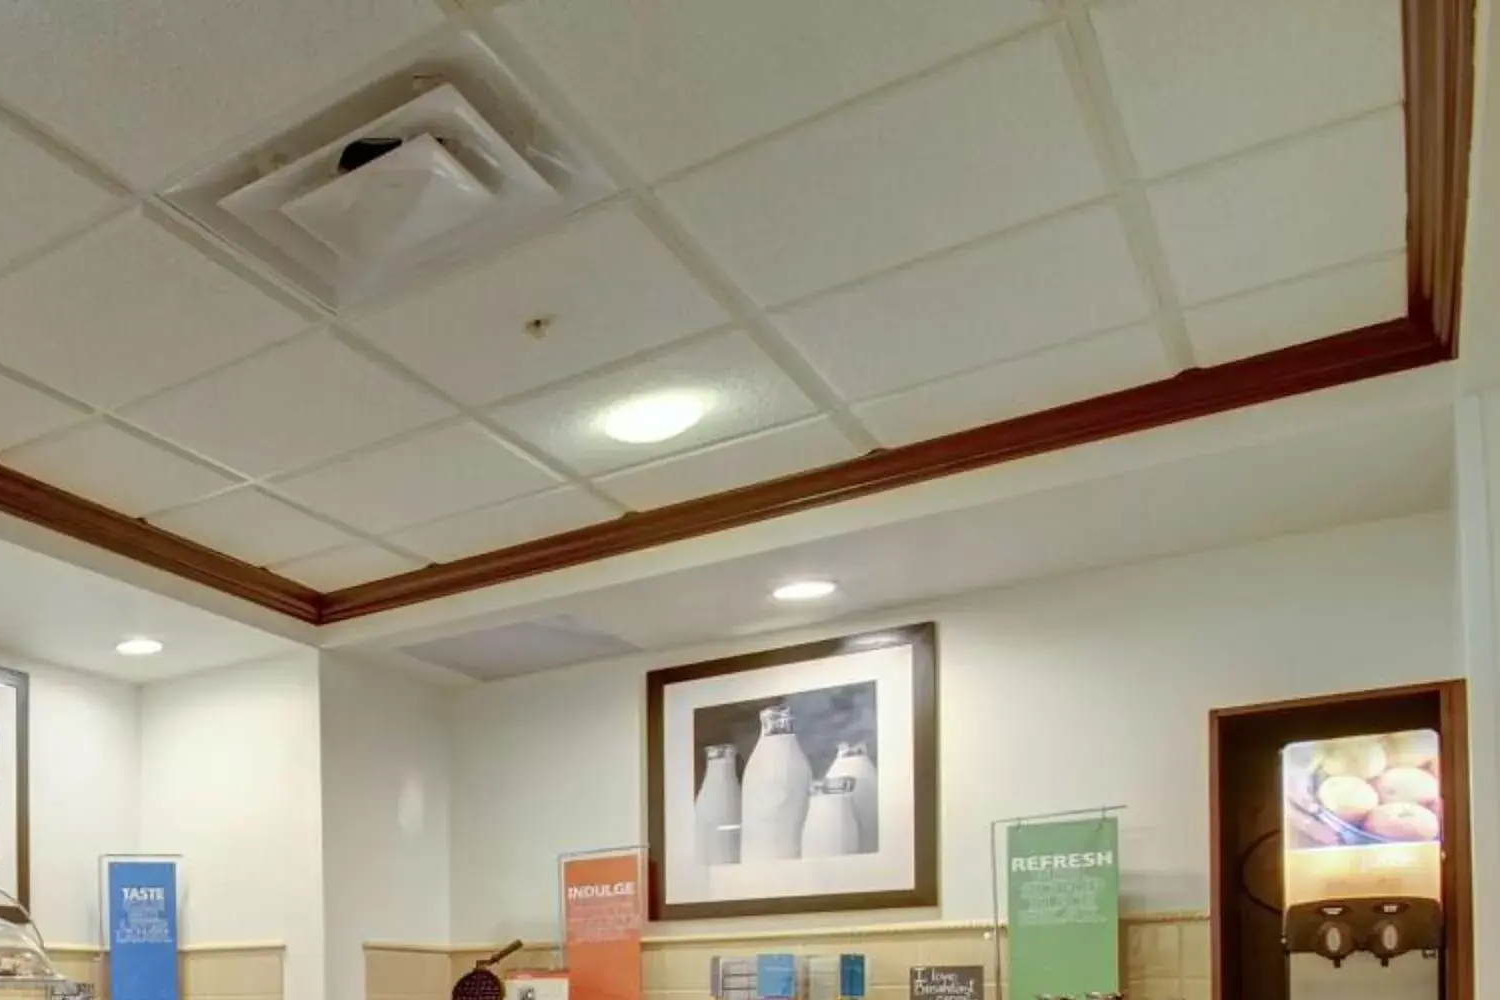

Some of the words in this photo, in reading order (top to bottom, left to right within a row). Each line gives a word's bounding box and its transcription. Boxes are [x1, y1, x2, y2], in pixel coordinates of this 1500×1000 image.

[1011, 851, 1113, 872] REFRESH
[121, 887, 165, 901] TASTE
[567, 882, 636, 899] INDULGE
